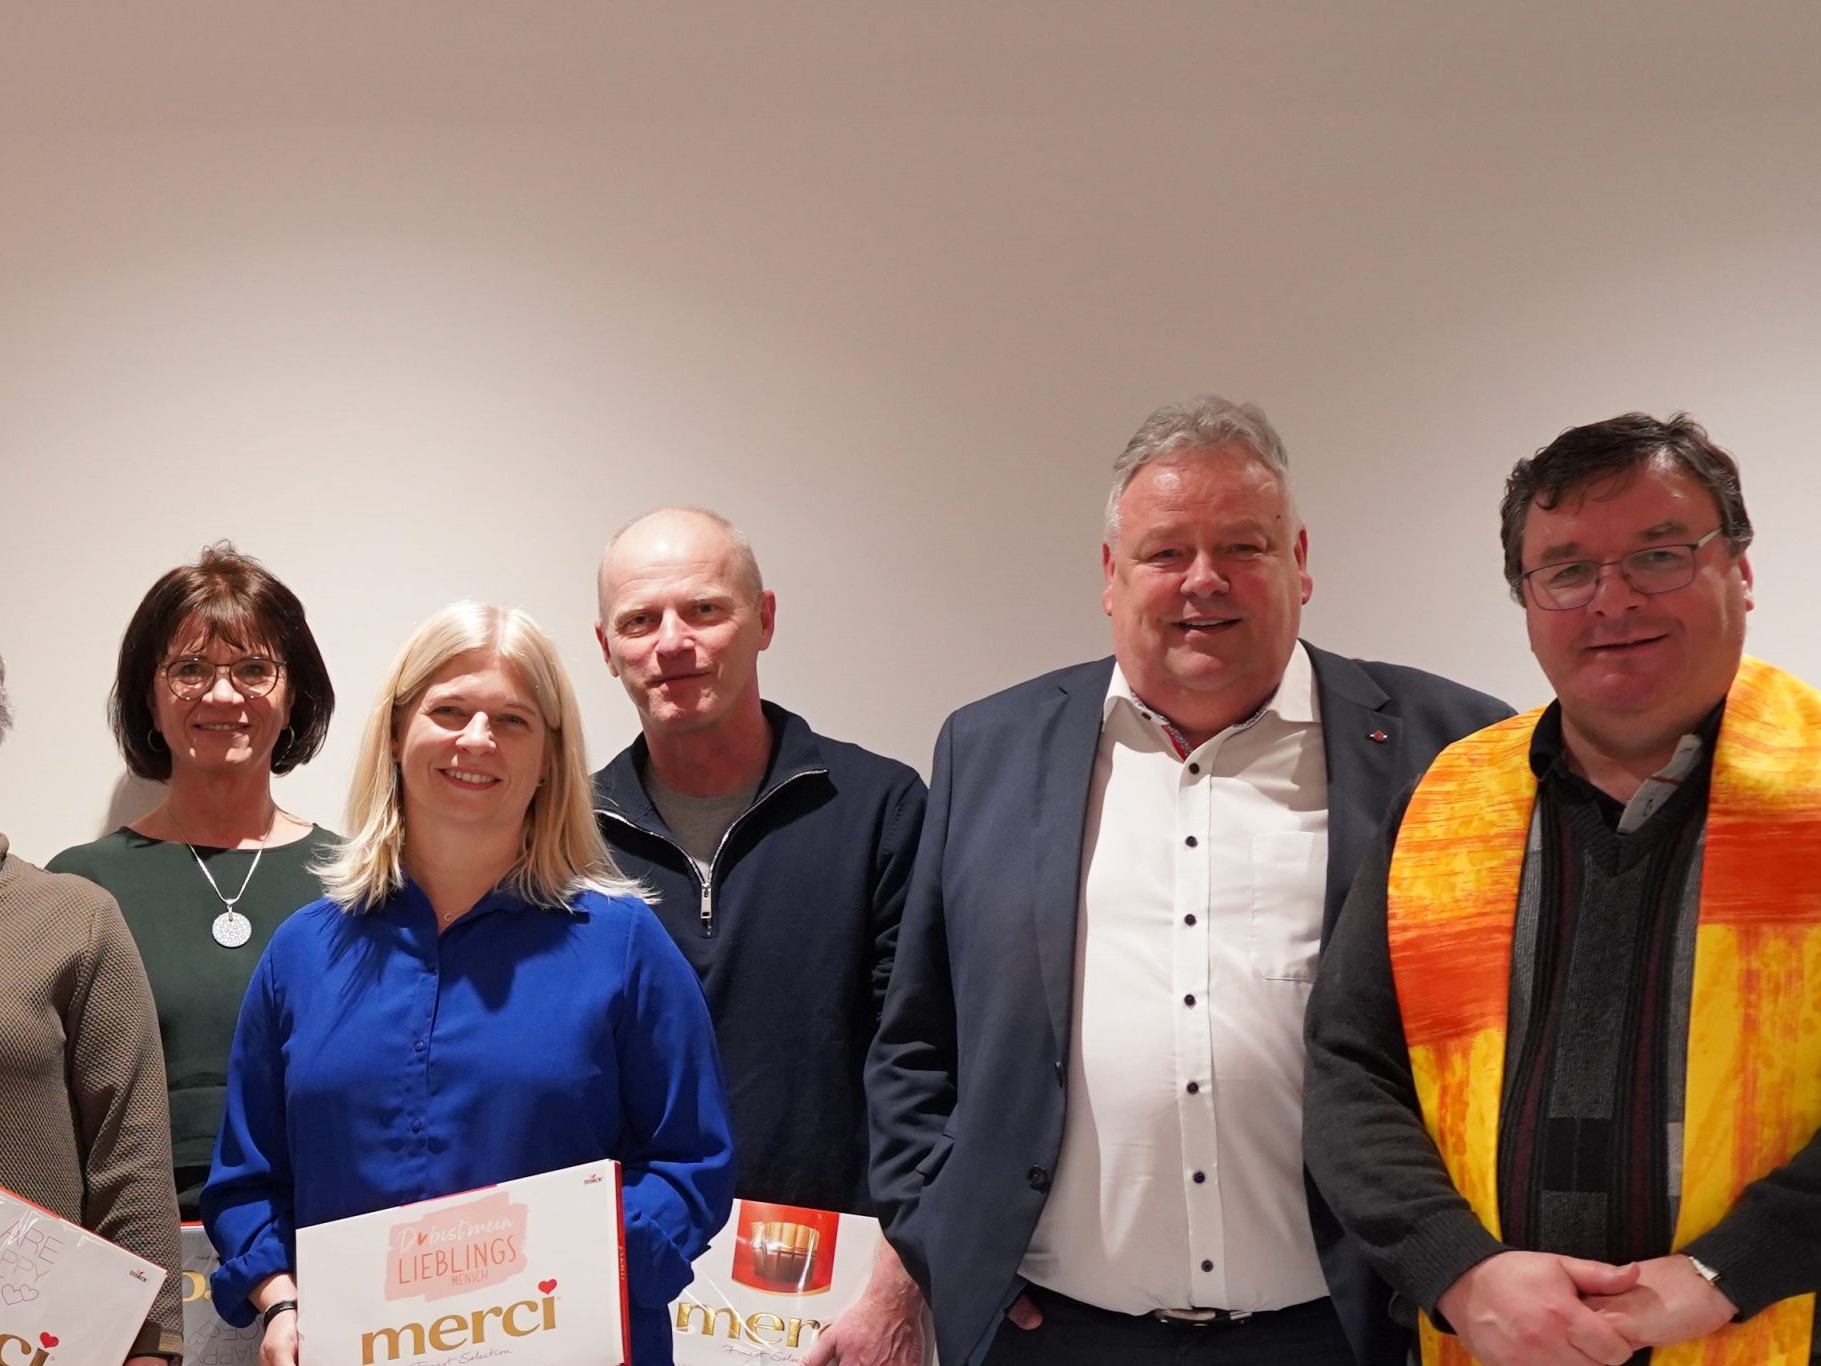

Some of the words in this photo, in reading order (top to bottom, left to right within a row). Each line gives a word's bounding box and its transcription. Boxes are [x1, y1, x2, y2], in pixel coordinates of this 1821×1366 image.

[0, 1220, 65, 1265] ARE
[398, 1233, 517, 1285] LIEBLINGS
[451, 1269, 489, 1288] MENSCH
[361, 1279, 558, 1366] merci
[676, 1301, 833, 1349] mer
[458, 1348, 514, 1366] Selection
